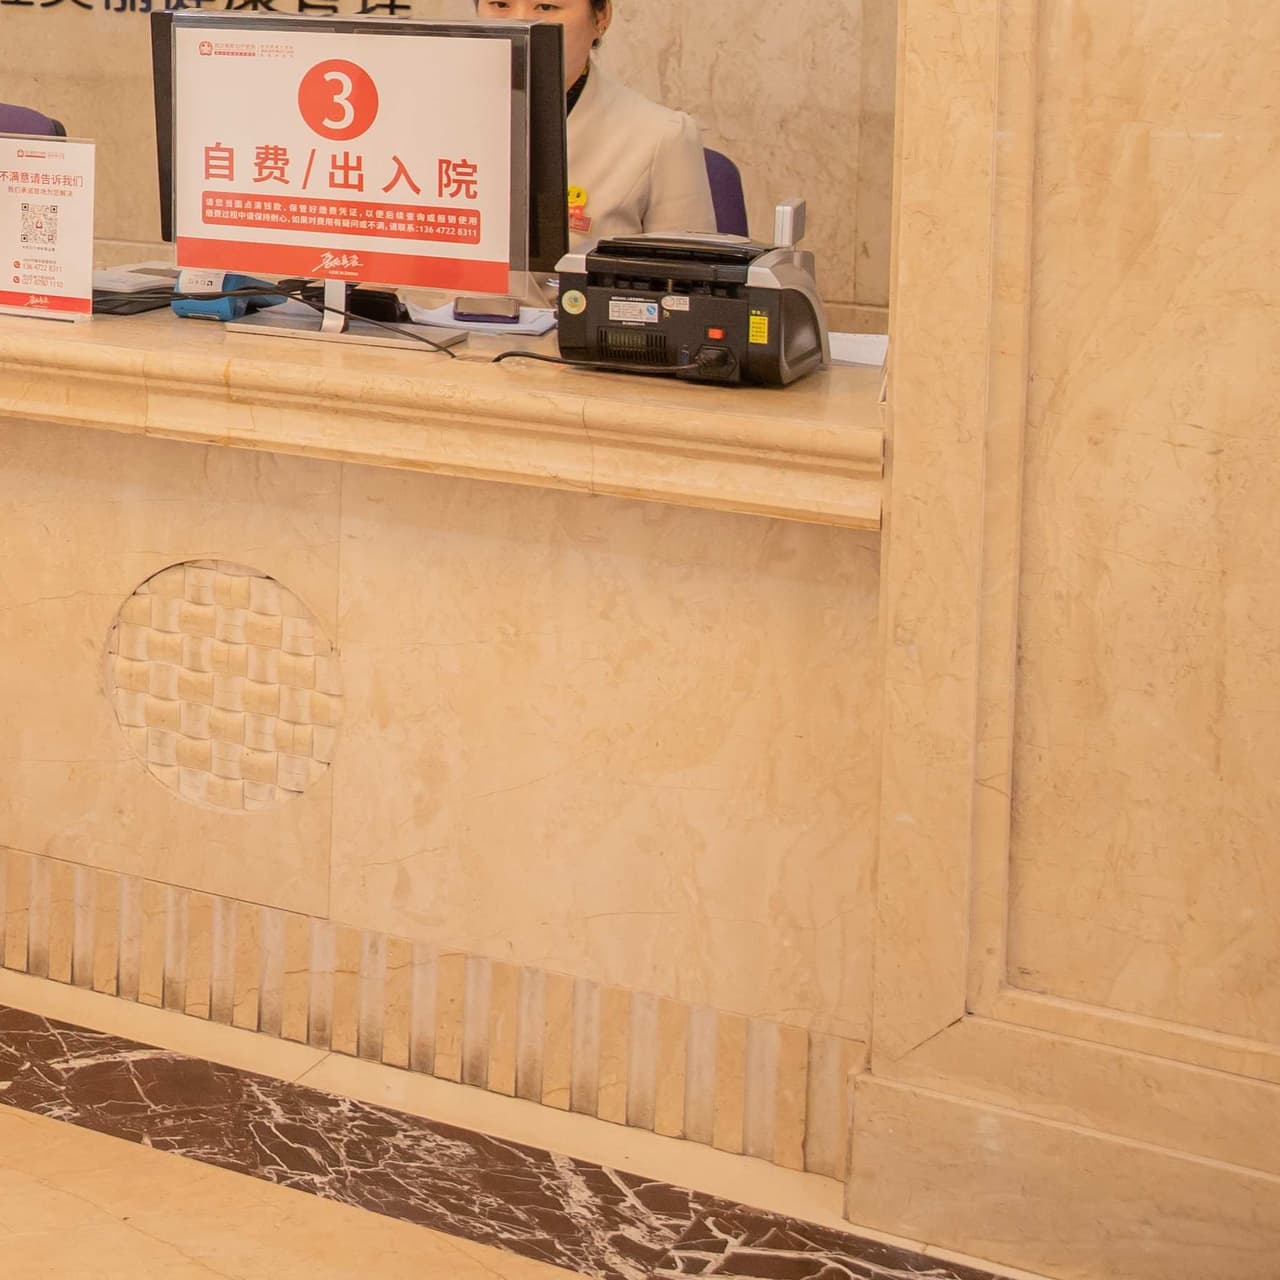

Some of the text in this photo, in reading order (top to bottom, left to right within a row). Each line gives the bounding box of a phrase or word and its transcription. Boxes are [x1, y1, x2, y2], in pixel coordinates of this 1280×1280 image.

[321, 70, 355, 130] 3
[0, 170, 84, 188] 不满意请告诉我们
[203, 142, 479, 200] 自费/出入院
